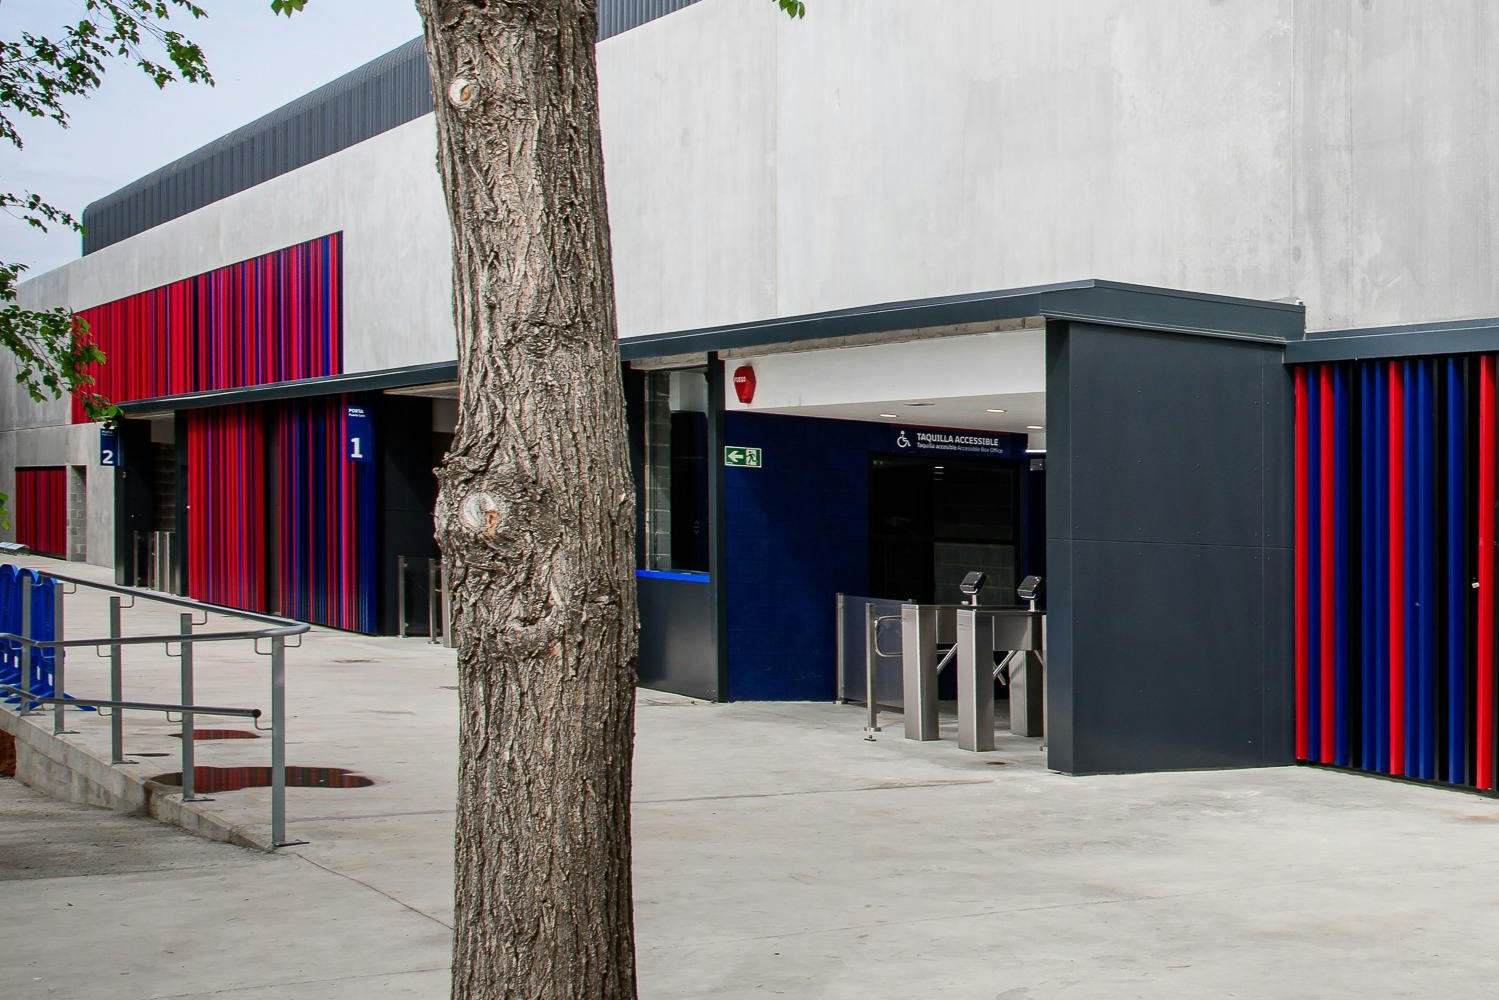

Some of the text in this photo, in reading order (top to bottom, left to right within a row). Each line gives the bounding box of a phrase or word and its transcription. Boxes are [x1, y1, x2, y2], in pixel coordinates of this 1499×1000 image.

[351, 437, 363, 458] 1
[916, 433, 999, 446] TAQUILLA ACCESSIBLE
[102, 449, 114, 465] 2
